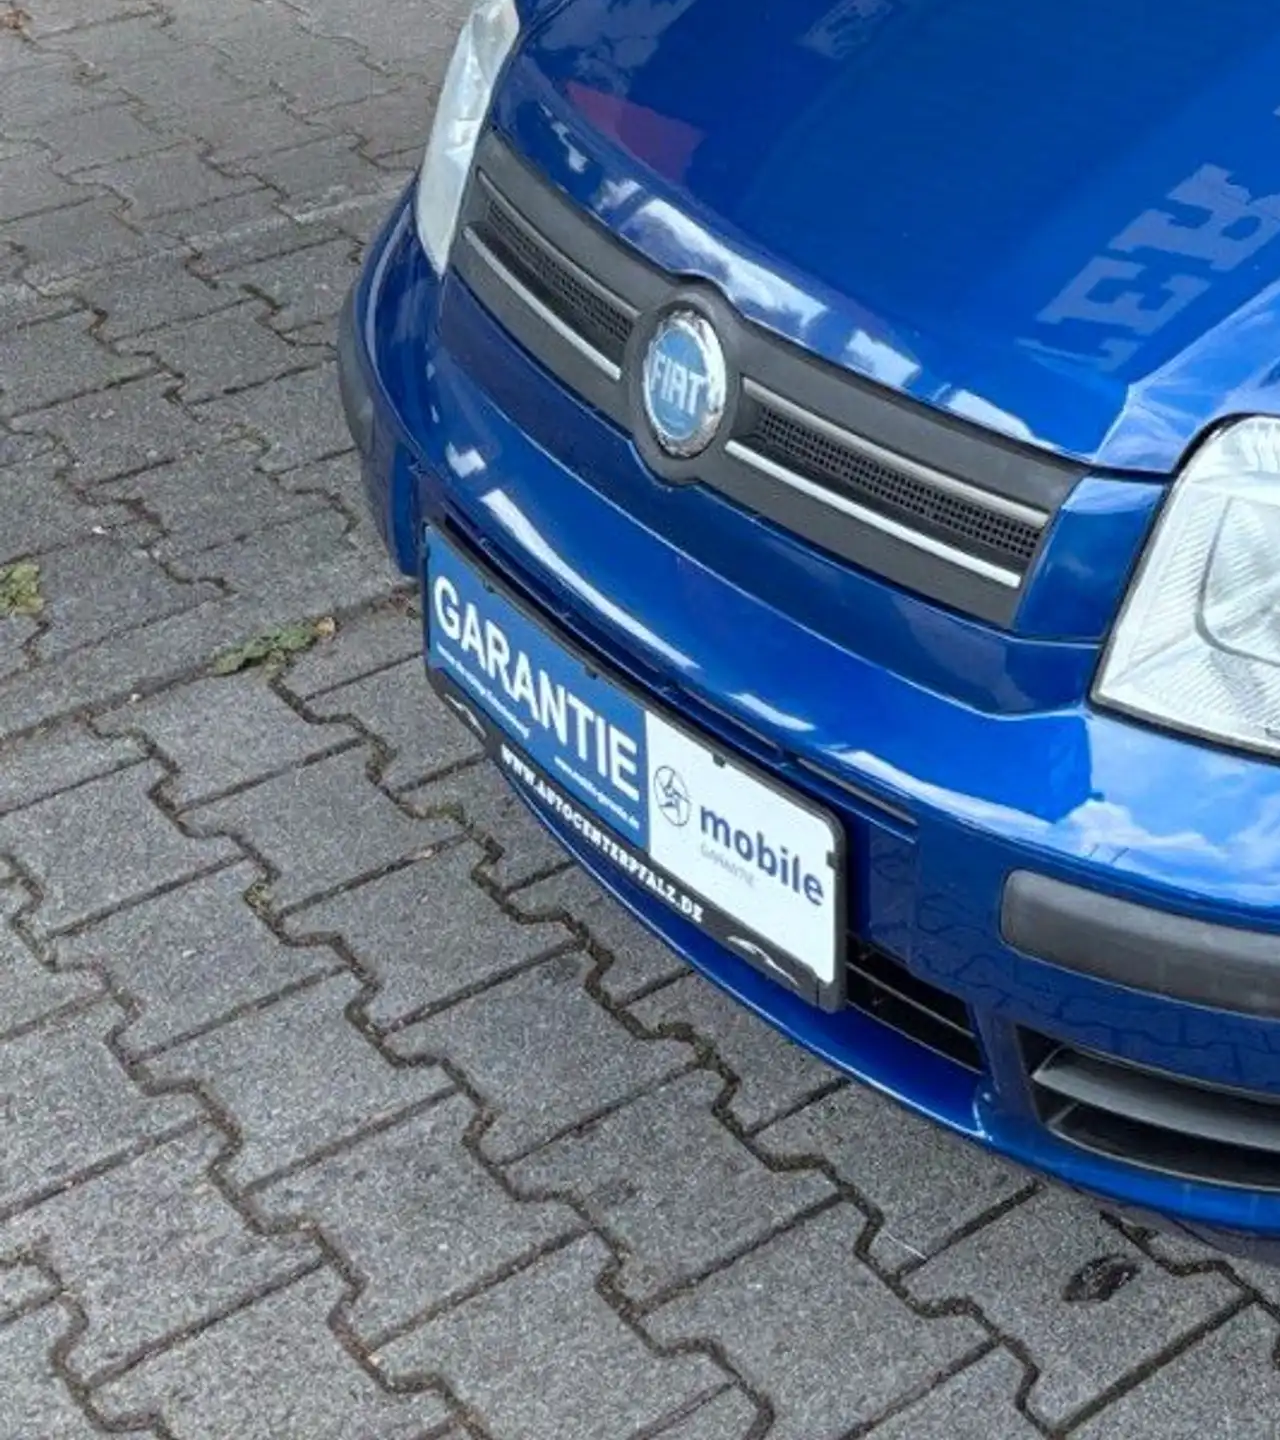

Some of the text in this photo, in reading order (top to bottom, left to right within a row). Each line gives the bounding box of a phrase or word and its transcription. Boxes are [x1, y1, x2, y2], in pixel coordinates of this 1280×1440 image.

[651, 350, 709, 418] FIAT
[434, 575, 640, 802] GARANTIE
[700, 805, 825, 907] mobile
